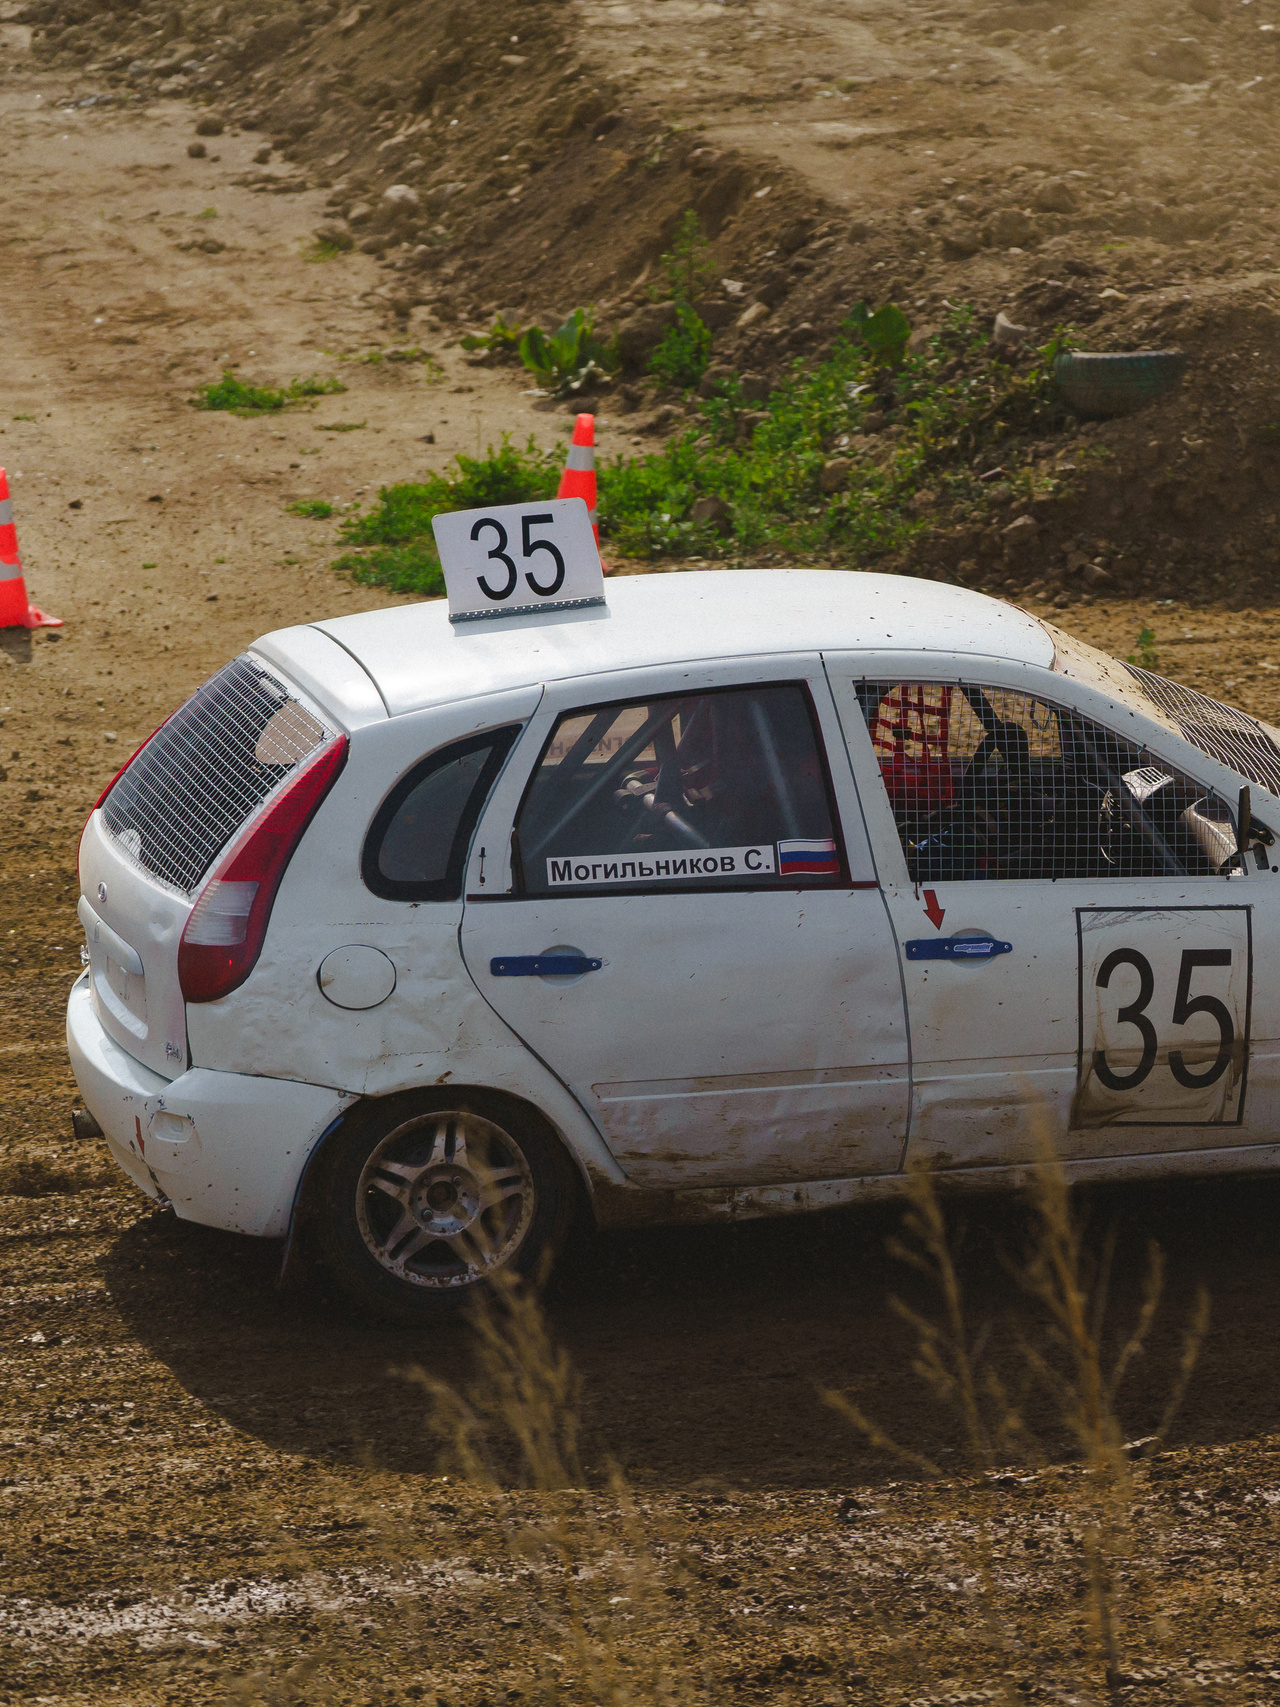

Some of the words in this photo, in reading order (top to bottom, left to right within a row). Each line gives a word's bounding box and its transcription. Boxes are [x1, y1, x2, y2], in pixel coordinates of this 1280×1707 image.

[470, 513, 565, 600] 35
[550, 855, 735, 882] Могильников
[744, 849, 771, 870] С.
[1092, 948, 1234, 1091] 35
